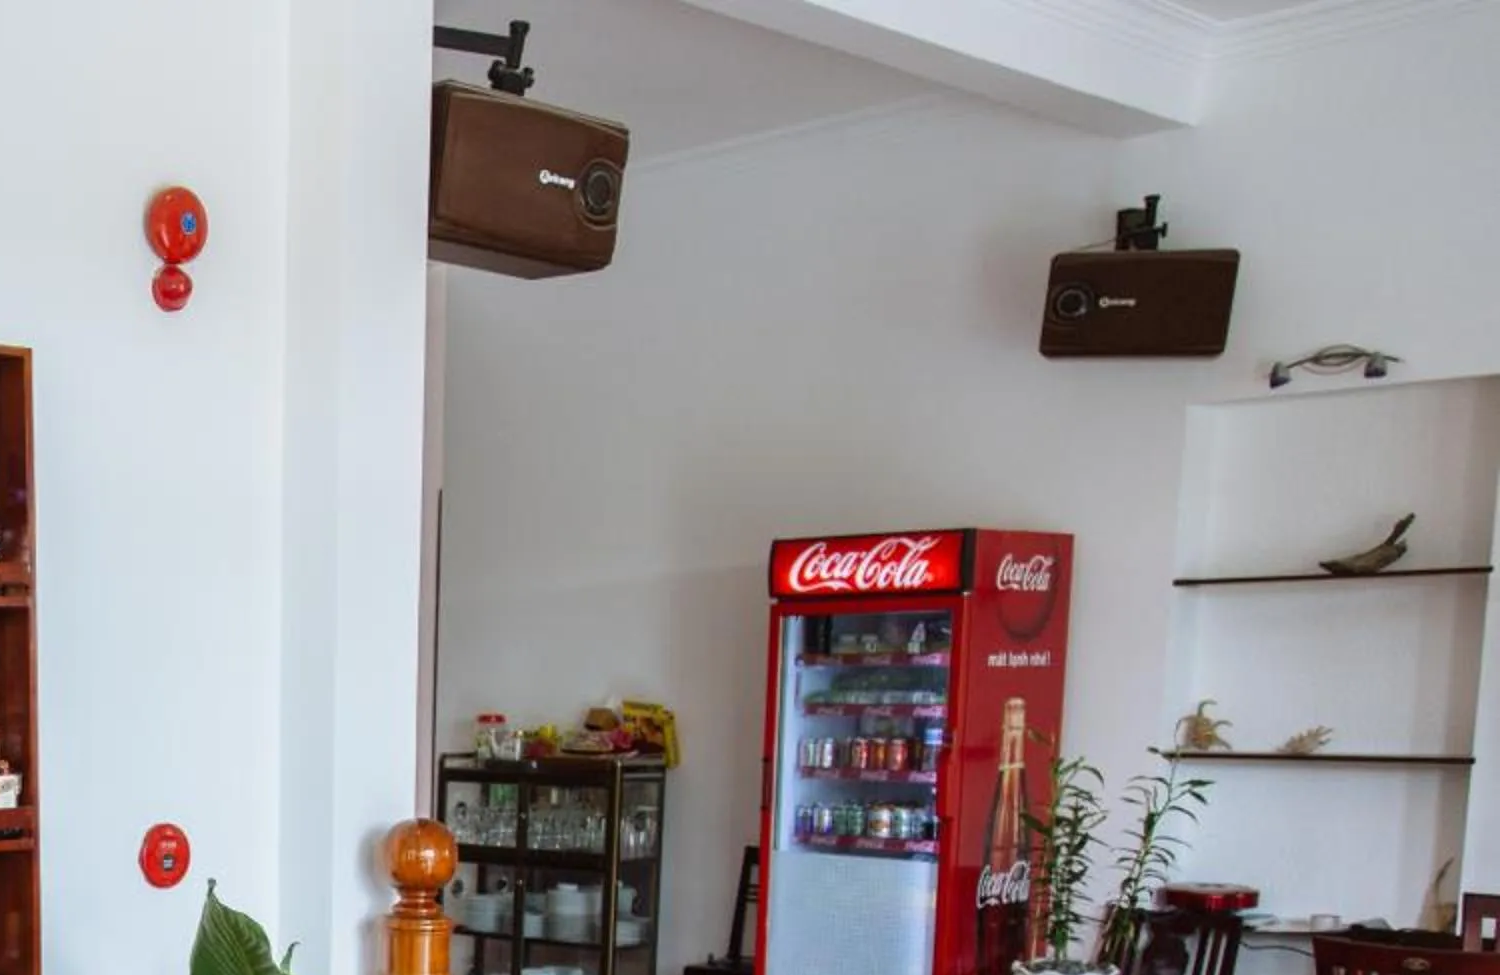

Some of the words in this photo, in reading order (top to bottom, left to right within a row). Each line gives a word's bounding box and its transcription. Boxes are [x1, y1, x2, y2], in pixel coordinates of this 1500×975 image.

[789, 535, 942, 593] Coca-Cola
[997, 553, 1053, 591] Coca-Cola
[976, 860, 1031, 909] Coca-Cola
